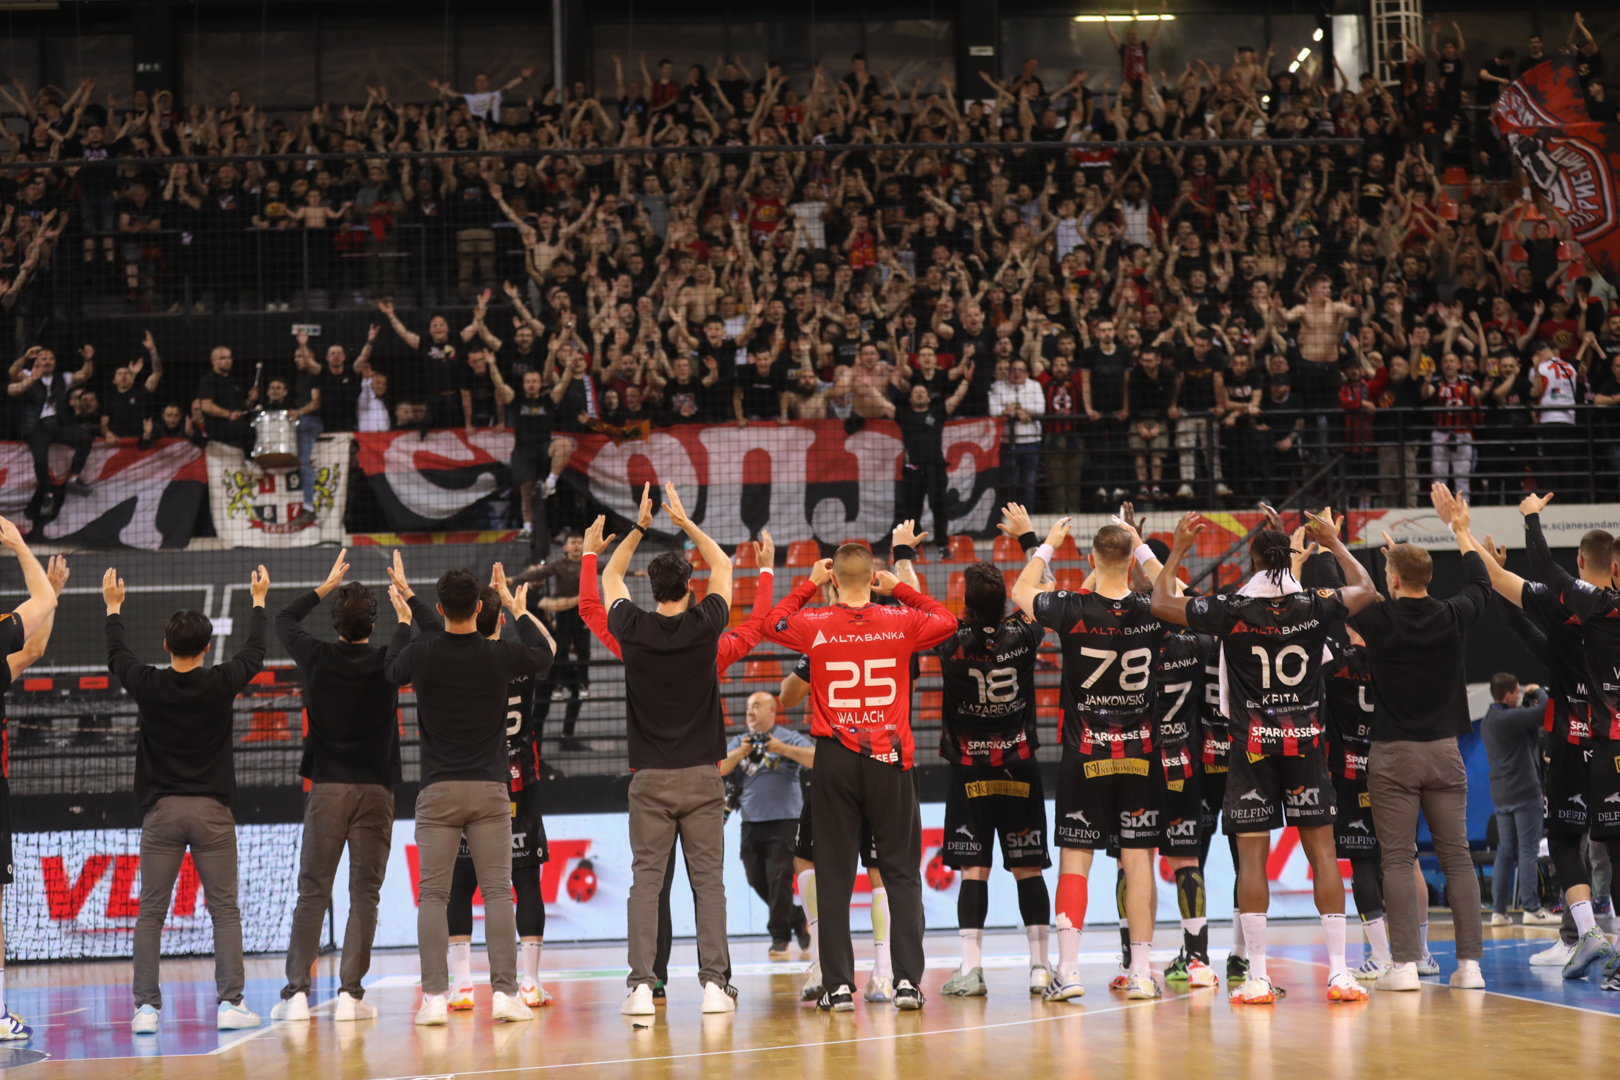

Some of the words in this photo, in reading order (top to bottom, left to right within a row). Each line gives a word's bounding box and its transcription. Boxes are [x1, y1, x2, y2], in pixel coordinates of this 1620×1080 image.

[829, 631, 905, 644] ALTABANKA
[1080, 646, 1152, 692] 78
[1251, 644, 1310, 688] 10
[826, 658, 896, 708] 25
[968, 667, 1020, 704] 18
[1084, 692, 1144, 706] JANKOWSKI
[1162, 680, 1192, 722] 7
[836, 710, 884, 724] WALACH
[1252, 726, 1312, 738] SPARKASSE
[1230, 805, 1274, 819] DELFINO
[1558, 810, 1588, 820] DELFIN
[1598, 811, 1620, 822] DELF
[1058, 826, 1100, 839] DELFINO
[1339, 836, 1376, 845] DELFINO
